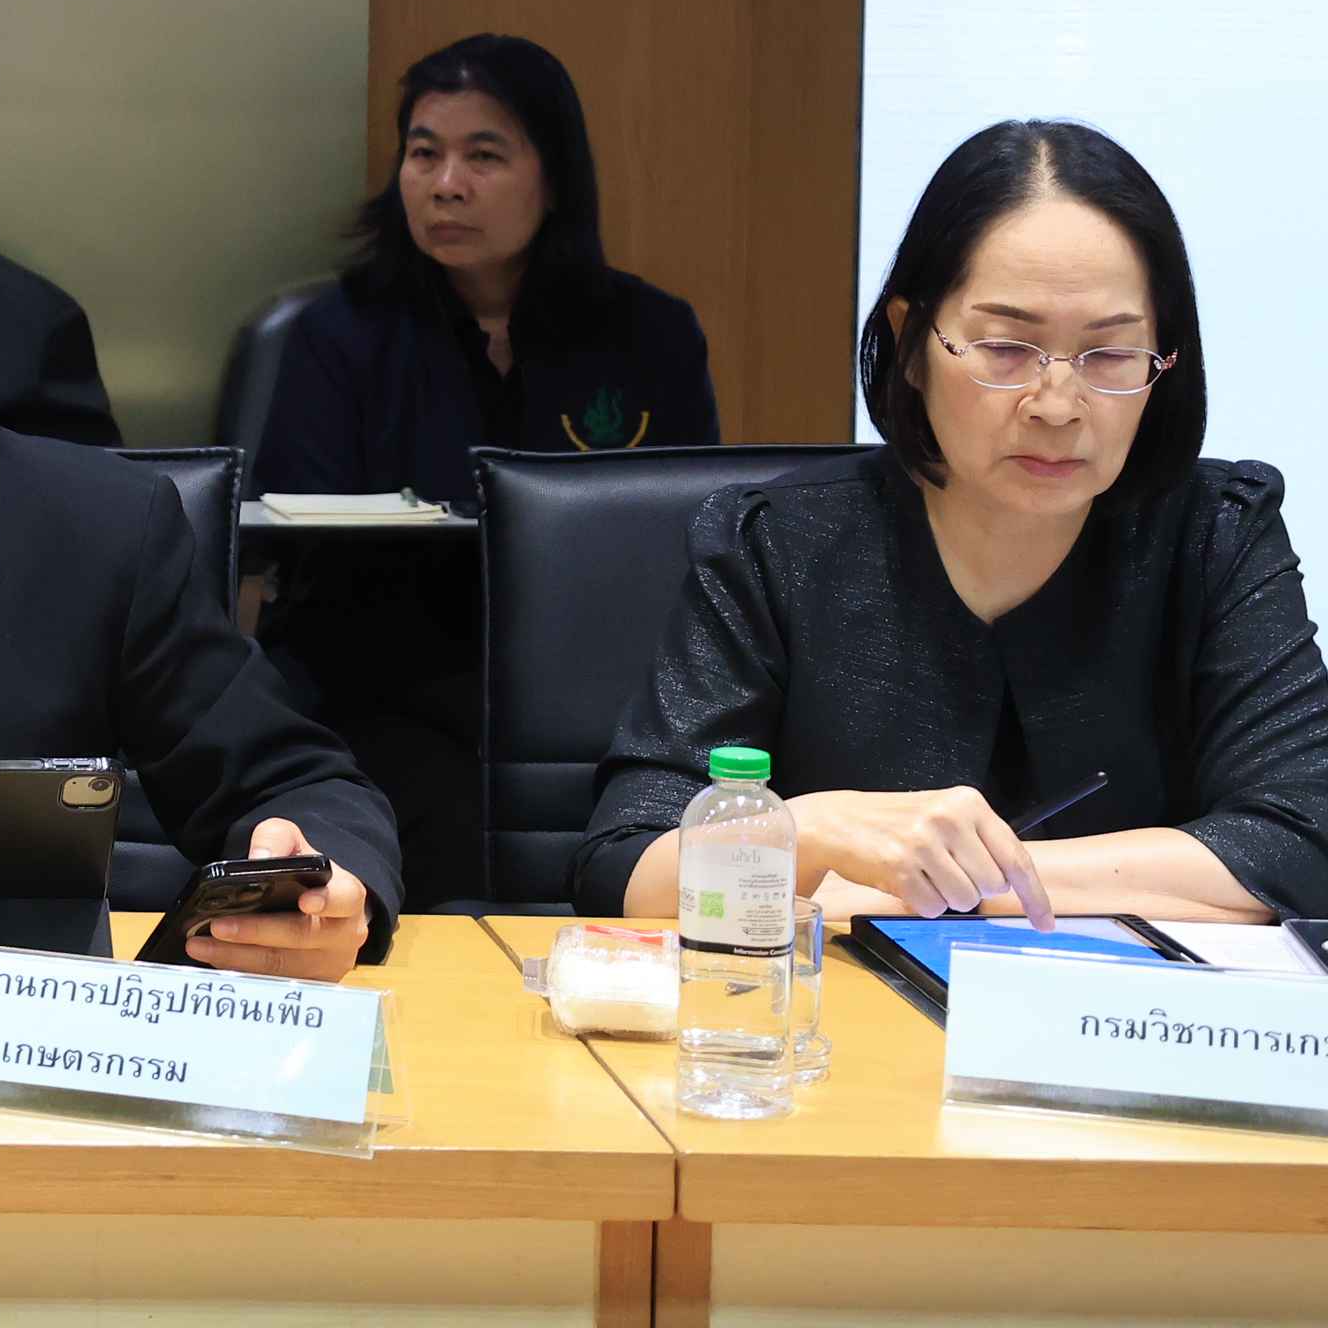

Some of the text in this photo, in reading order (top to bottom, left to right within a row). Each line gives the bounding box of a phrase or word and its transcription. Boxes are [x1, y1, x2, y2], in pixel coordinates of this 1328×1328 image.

[733, 947, 769, 956] Information
[2, 1039, 188, 1083] เกษตรกรรม
